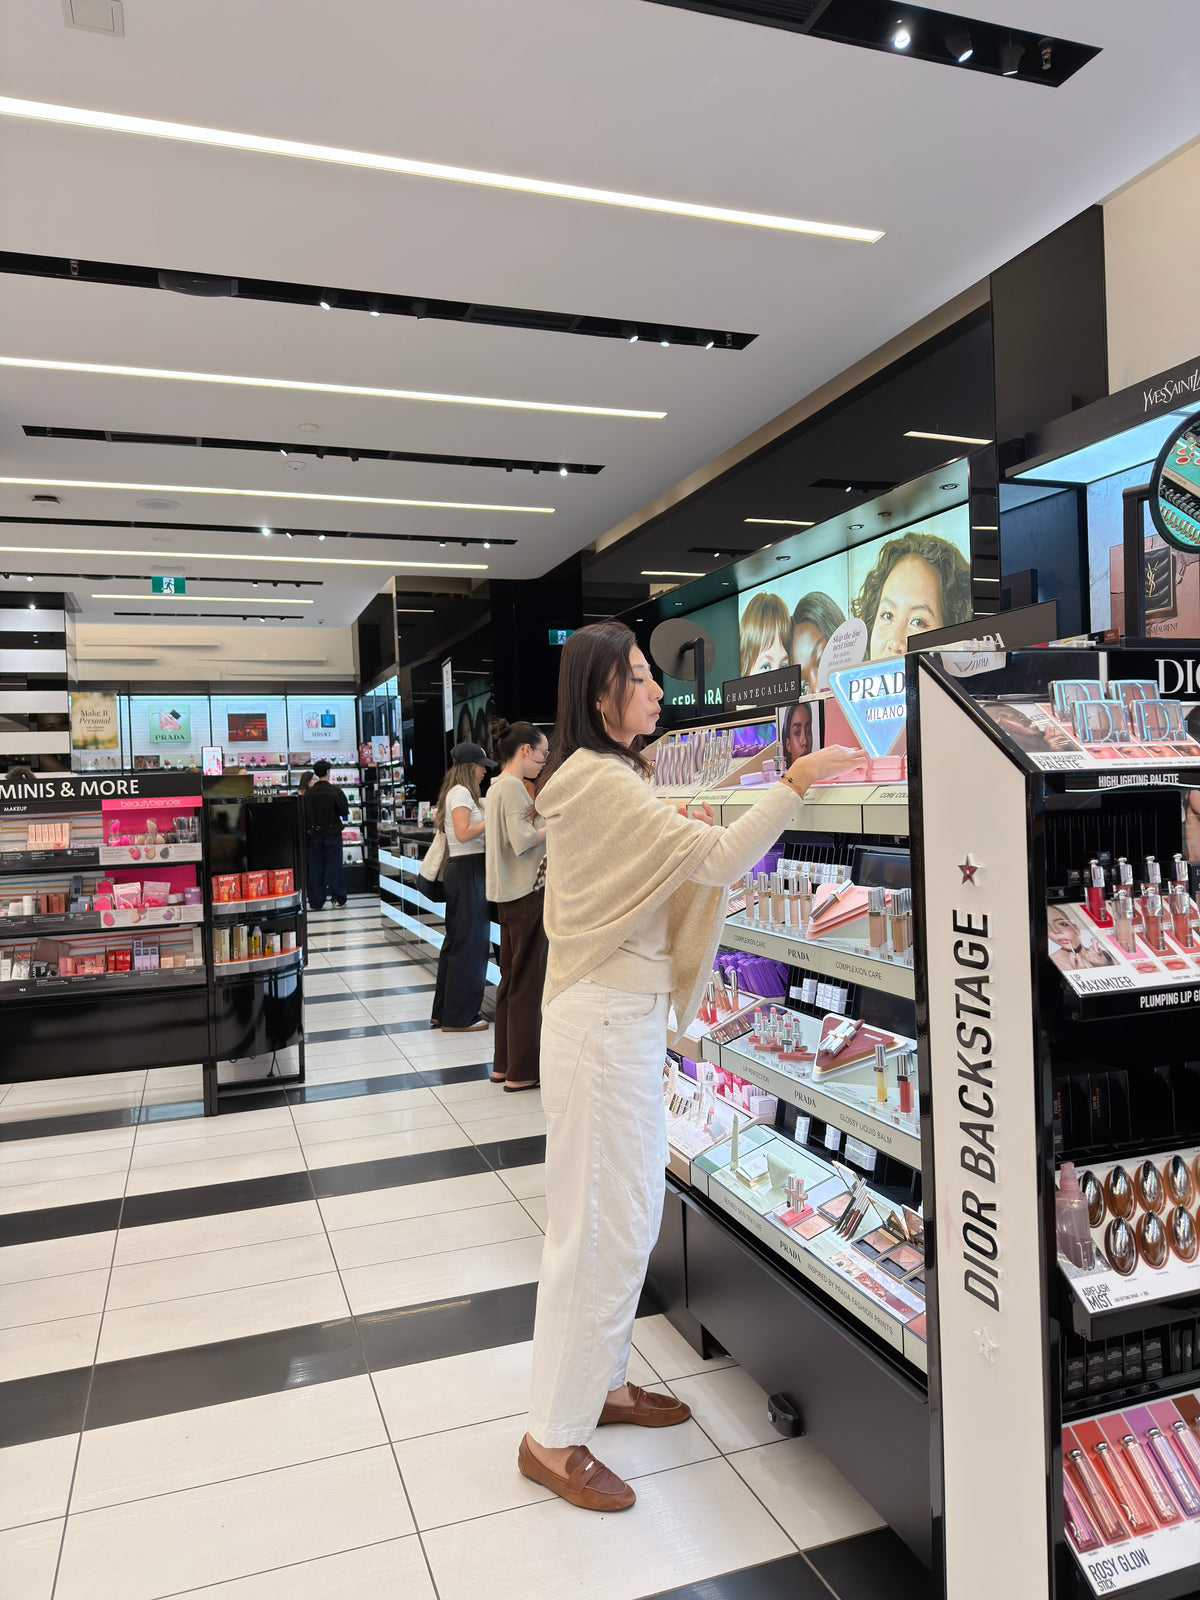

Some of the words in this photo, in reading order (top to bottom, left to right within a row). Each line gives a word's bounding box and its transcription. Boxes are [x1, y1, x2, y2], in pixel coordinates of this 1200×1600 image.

[849, 671, 905, 701] PRAD
[1155, 658, 1200, 695] DI
[726, 680, 796, 703] CHANTECAILLE
[865, 705, 904, 721] MILANO
[1038, 759, 1083, 769] PALETTE
[0, 782, 55, 800] MINIS
[60, 781, 76, 798] &
[80, 779, 140, 797] MORE
[1098, 775, 1149, 788] HIGHLIGHTING
[1150, 773, 1180, 786] PALETTE
[787, 948, 810, 962] PRADA
[835, 961, 867, 976] COMPLEXION
[866, 969, 883, 981] CARE
[1070, 973, 1081, 982] LIP
[1075, 976, 1136, 993] MAXIMIZER
[1140, 992, 1179, 1009] PLUMPING
[1179, 990, 1192, 1004] LIP
[952, 908, 997, 1185] BACKSTAGE
[794, 1089, 817, 1108] PRADA
[779, 1240, 802, 1263] PRADA
[962, 1189, 1001, 1313] DIOR
[1081, 1283, 1111, 1297] AIRFLASH
[1086, 1293, 1113, 1311] MIST
[1087, 1557, 1119, 1582] ROSY
[1117, 1547, 1151, 1573] GLOW
[1097, 1578, 1117, 1592] STICK
